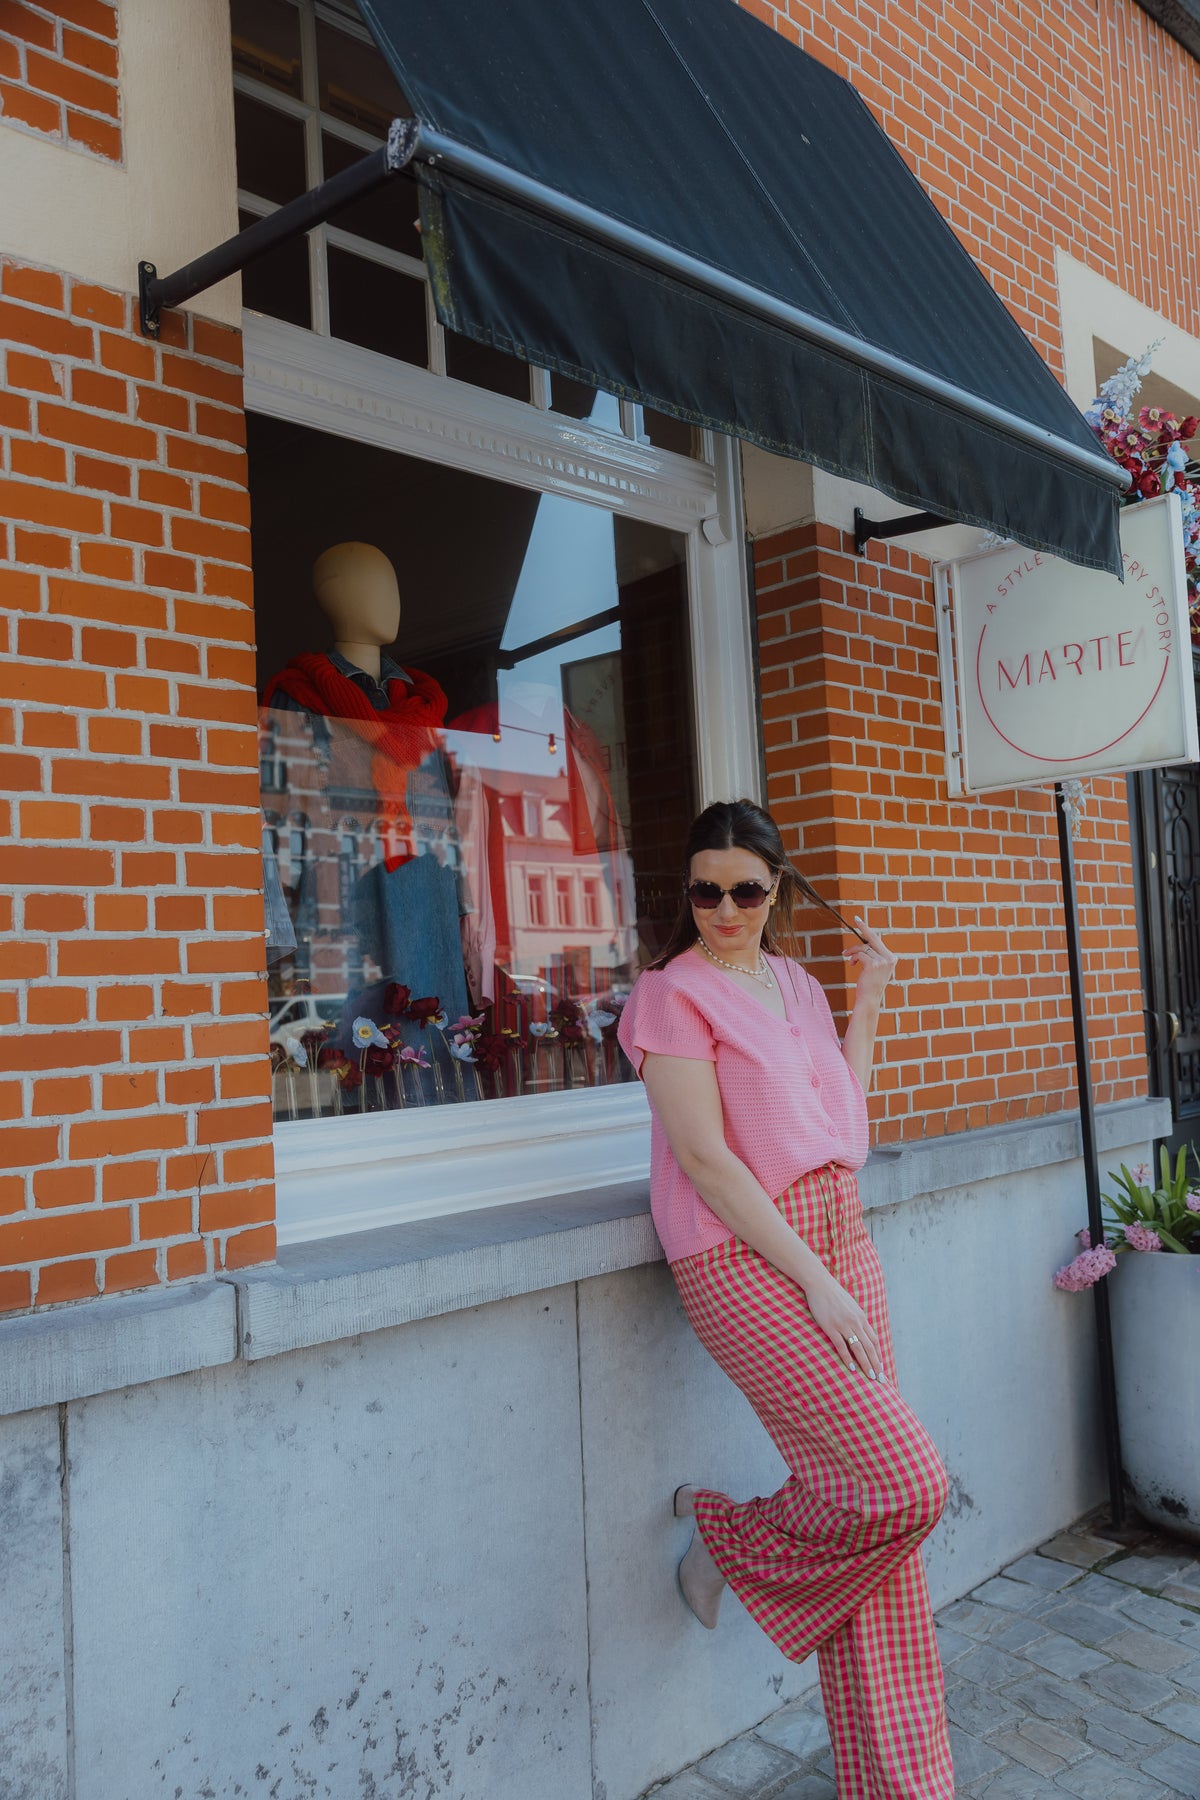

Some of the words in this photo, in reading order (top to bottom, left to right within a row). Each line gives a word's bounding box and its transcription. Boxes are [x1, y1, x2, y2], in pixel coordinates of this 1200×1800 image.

[986, 604, 997, 614] A
[997, 552, 1043, 596] STYLE
[1122, 553, 1149, 581] ERY
[1145, 586, 1172, 653] STORY
[997, 630, 1136, 692] MARTE
